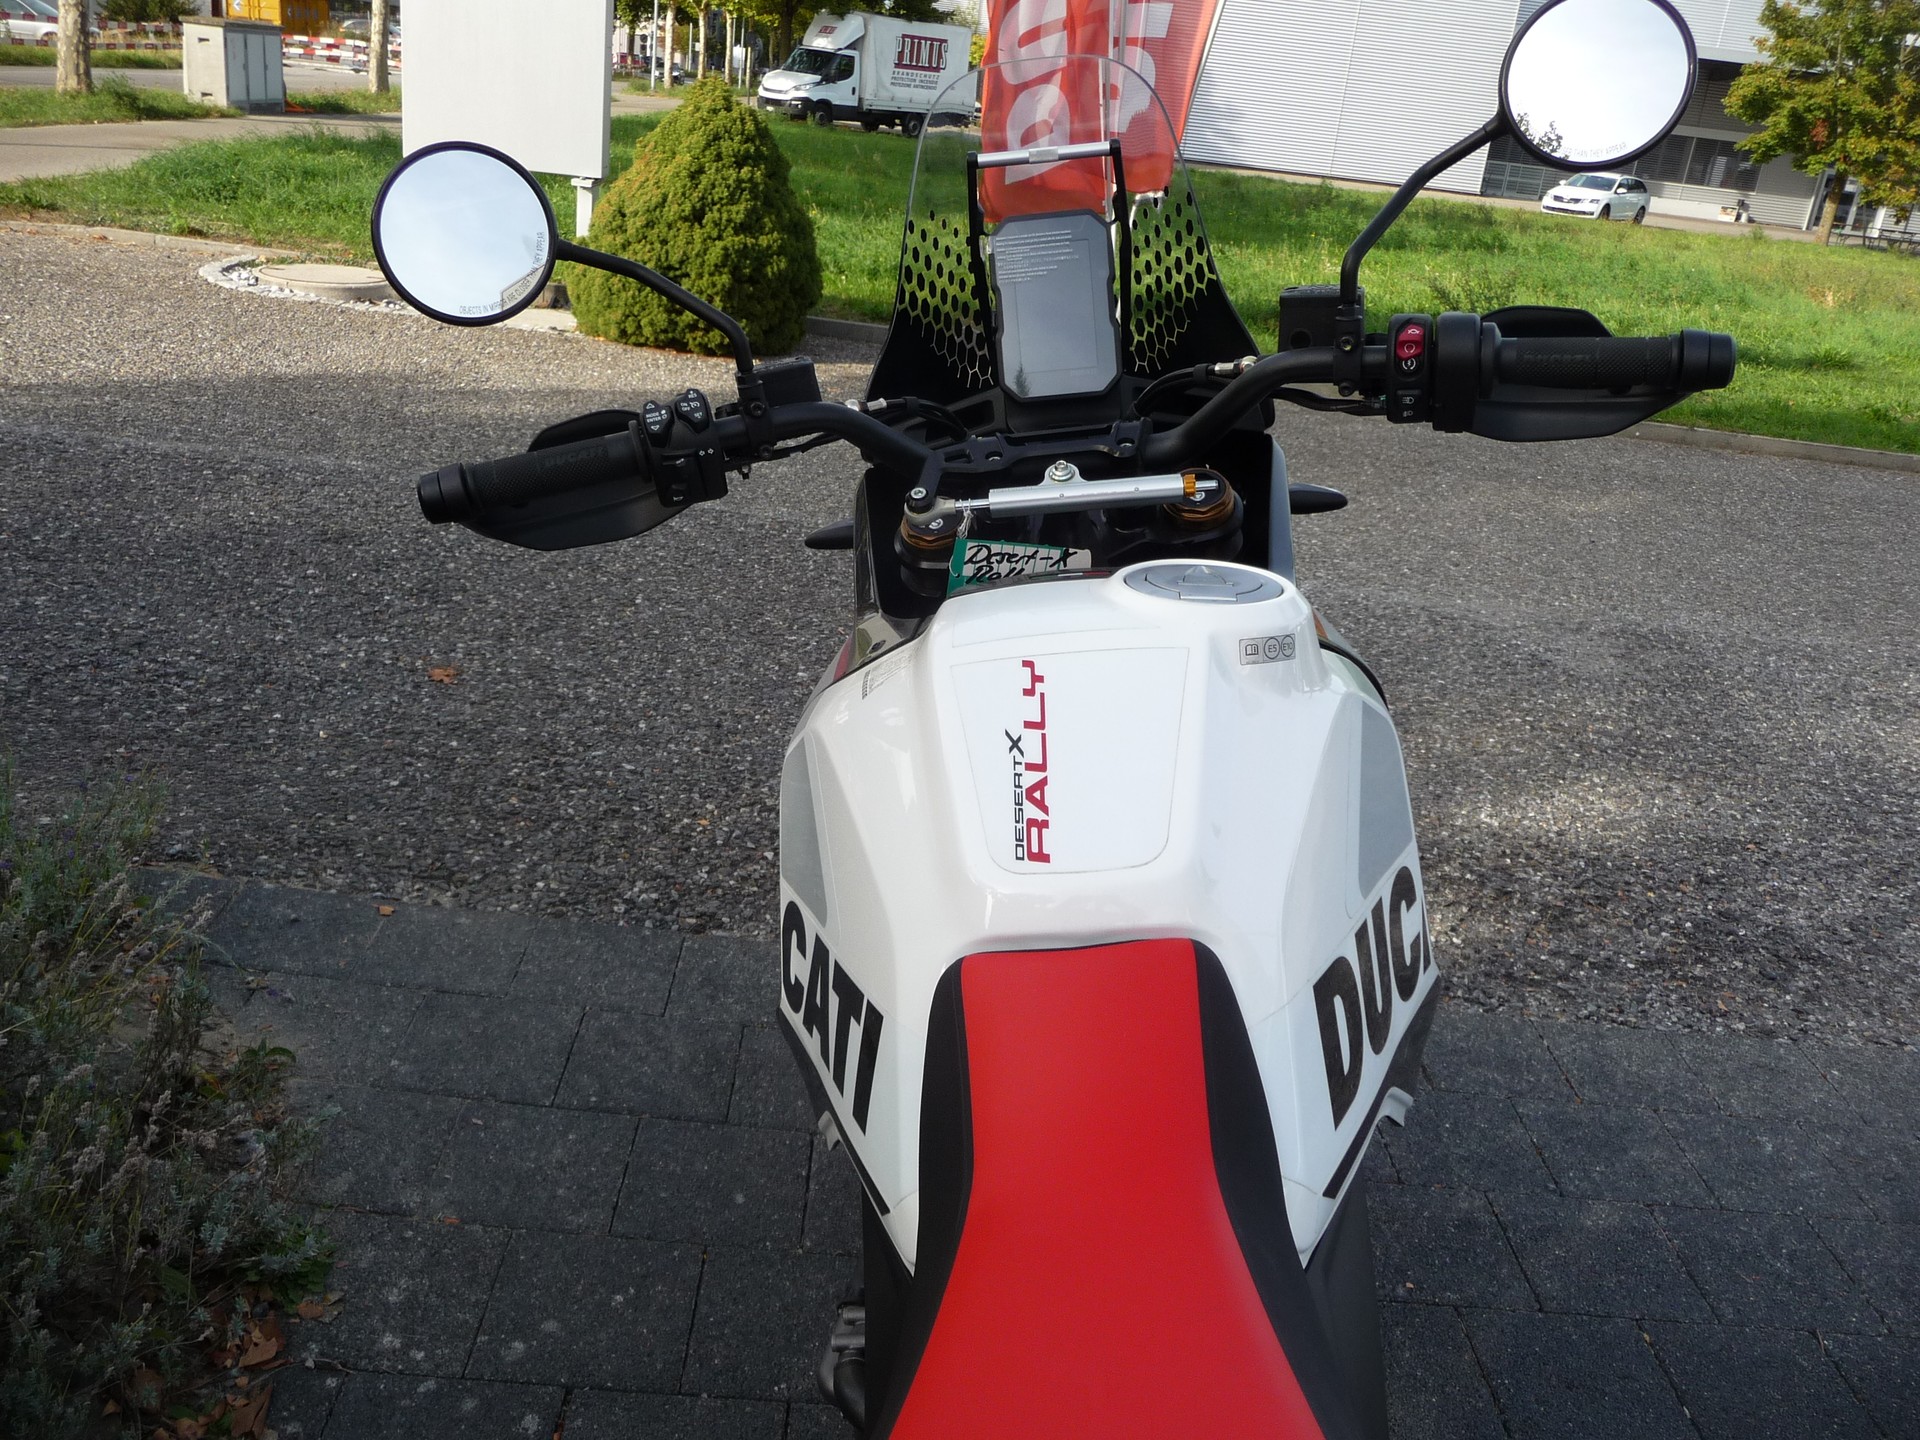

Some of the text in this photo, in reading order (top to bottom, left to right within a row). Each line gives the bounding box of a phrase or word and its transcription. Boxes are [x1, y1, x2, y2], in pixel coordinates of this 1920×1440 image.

[893, 36, 948, 70] PRIMUS
[892, 70, 940, 80] BRANDSCHUTZ
[459, 305, 482, 315] OBJECTS
[483, 304, 489, 313] IN
[1267, 644, 1278, 653] E5
[1021, 659, 1051, 864] RALLY
[782, 900, 884, 1137] CATI
